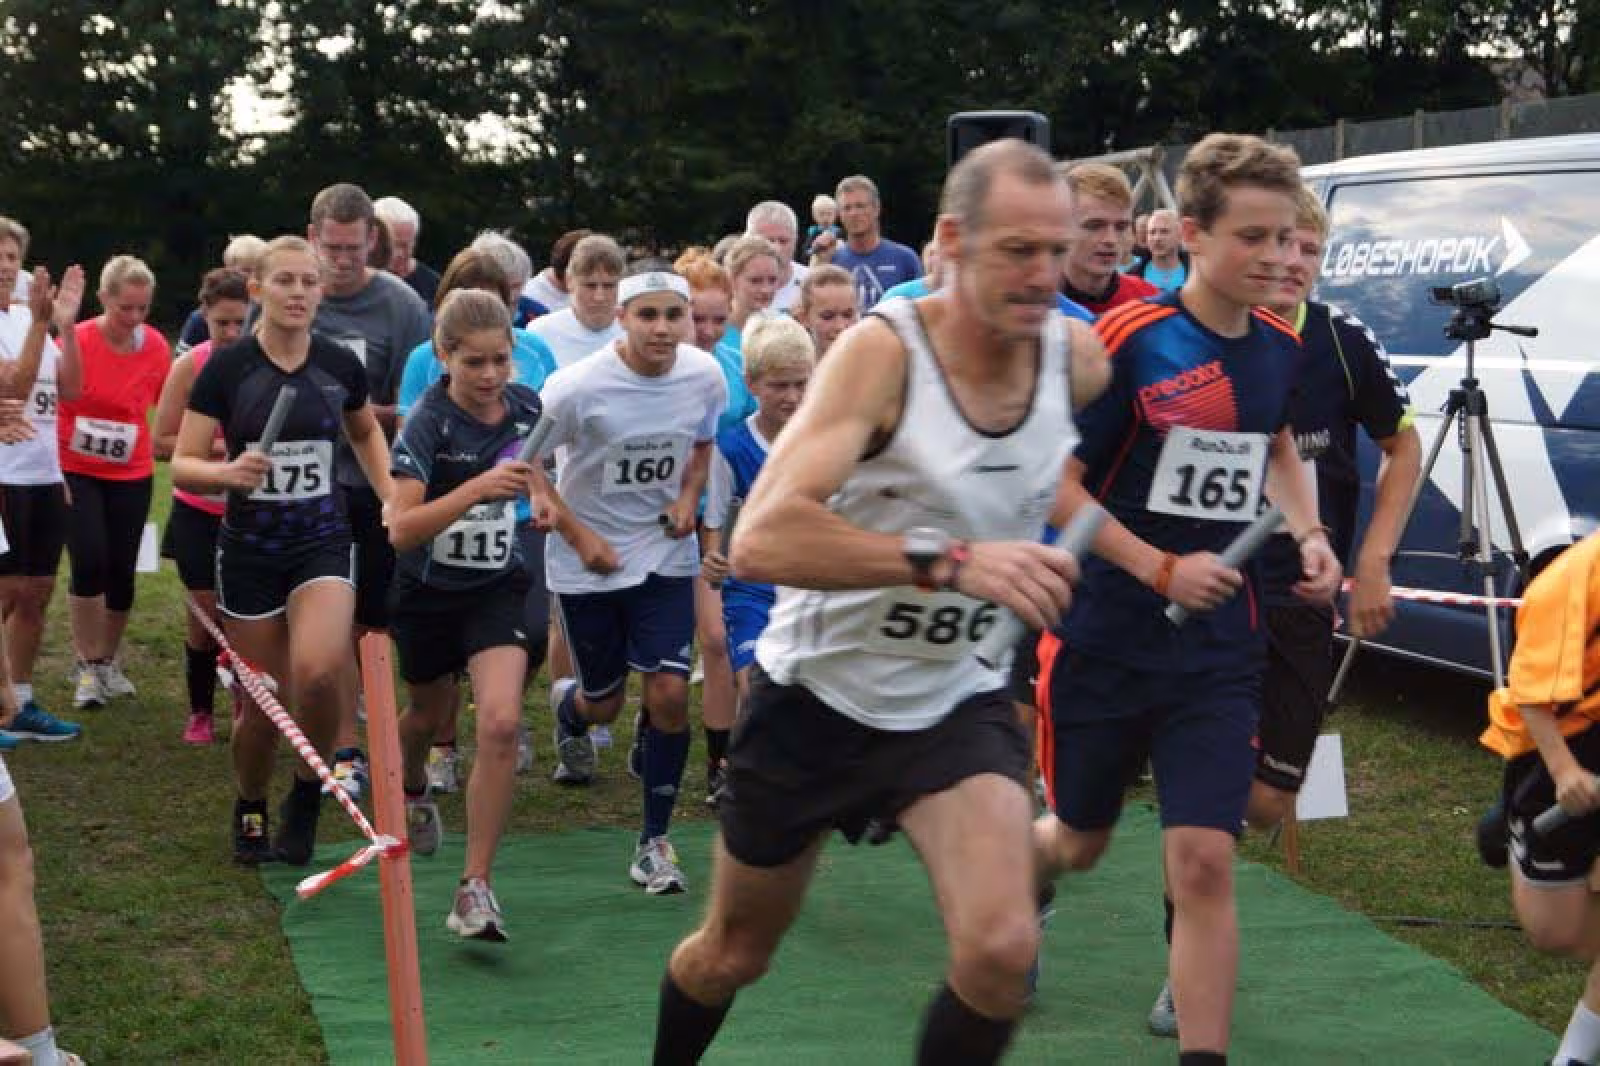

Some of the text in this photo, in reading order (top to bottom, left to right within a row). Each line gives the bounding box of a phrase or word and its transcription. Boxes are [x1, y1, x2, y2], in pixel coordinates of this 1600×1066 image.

[80, 433, 128, 459] 118
[262, 462, 321, 495] 175
[614, 455, 675, 485] 160
[1168, 463, 1250, 512] 165
[446, 529, 508, 562] 115
[880, 600, 1000, 644] 586
